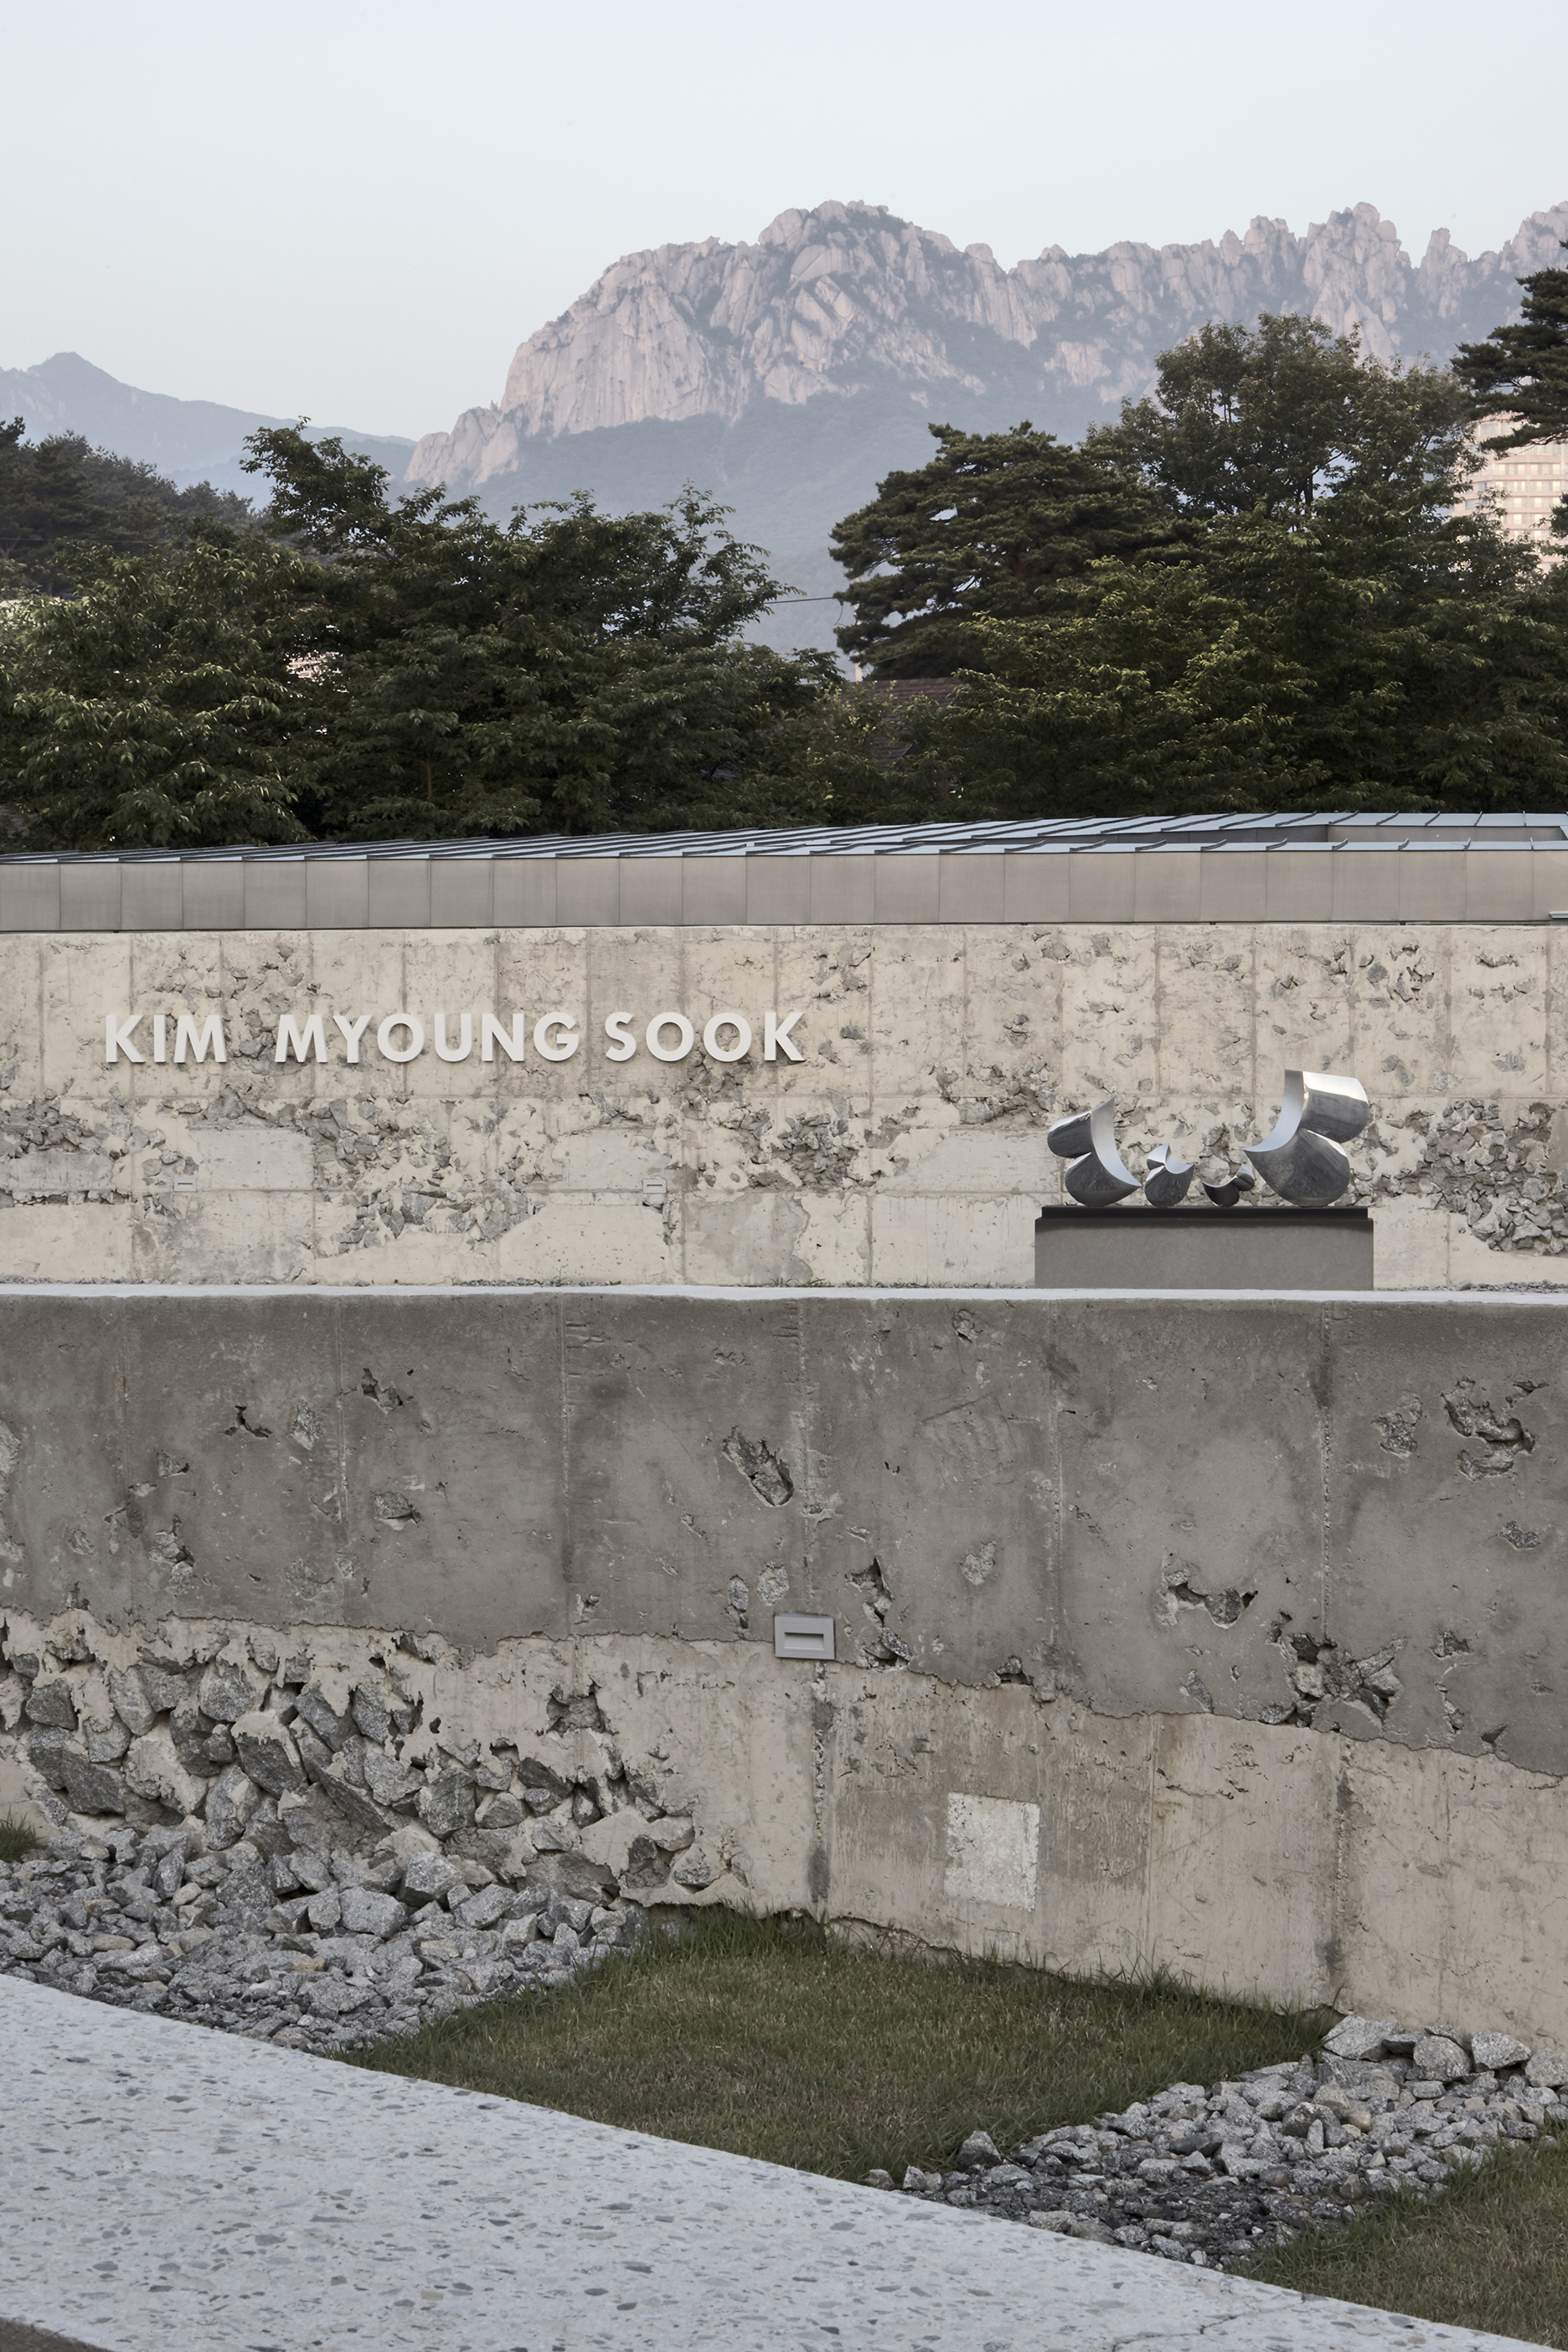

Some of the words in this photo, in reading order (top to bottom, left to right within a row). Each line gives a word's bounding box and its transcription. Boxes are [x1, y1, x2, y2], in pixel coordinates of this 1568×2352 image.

[106, 1014, 228, 1064] KIM
[274, 1012, 580, 1064] MYOUNG
[605, 1011, 806, 1062] SOOK
